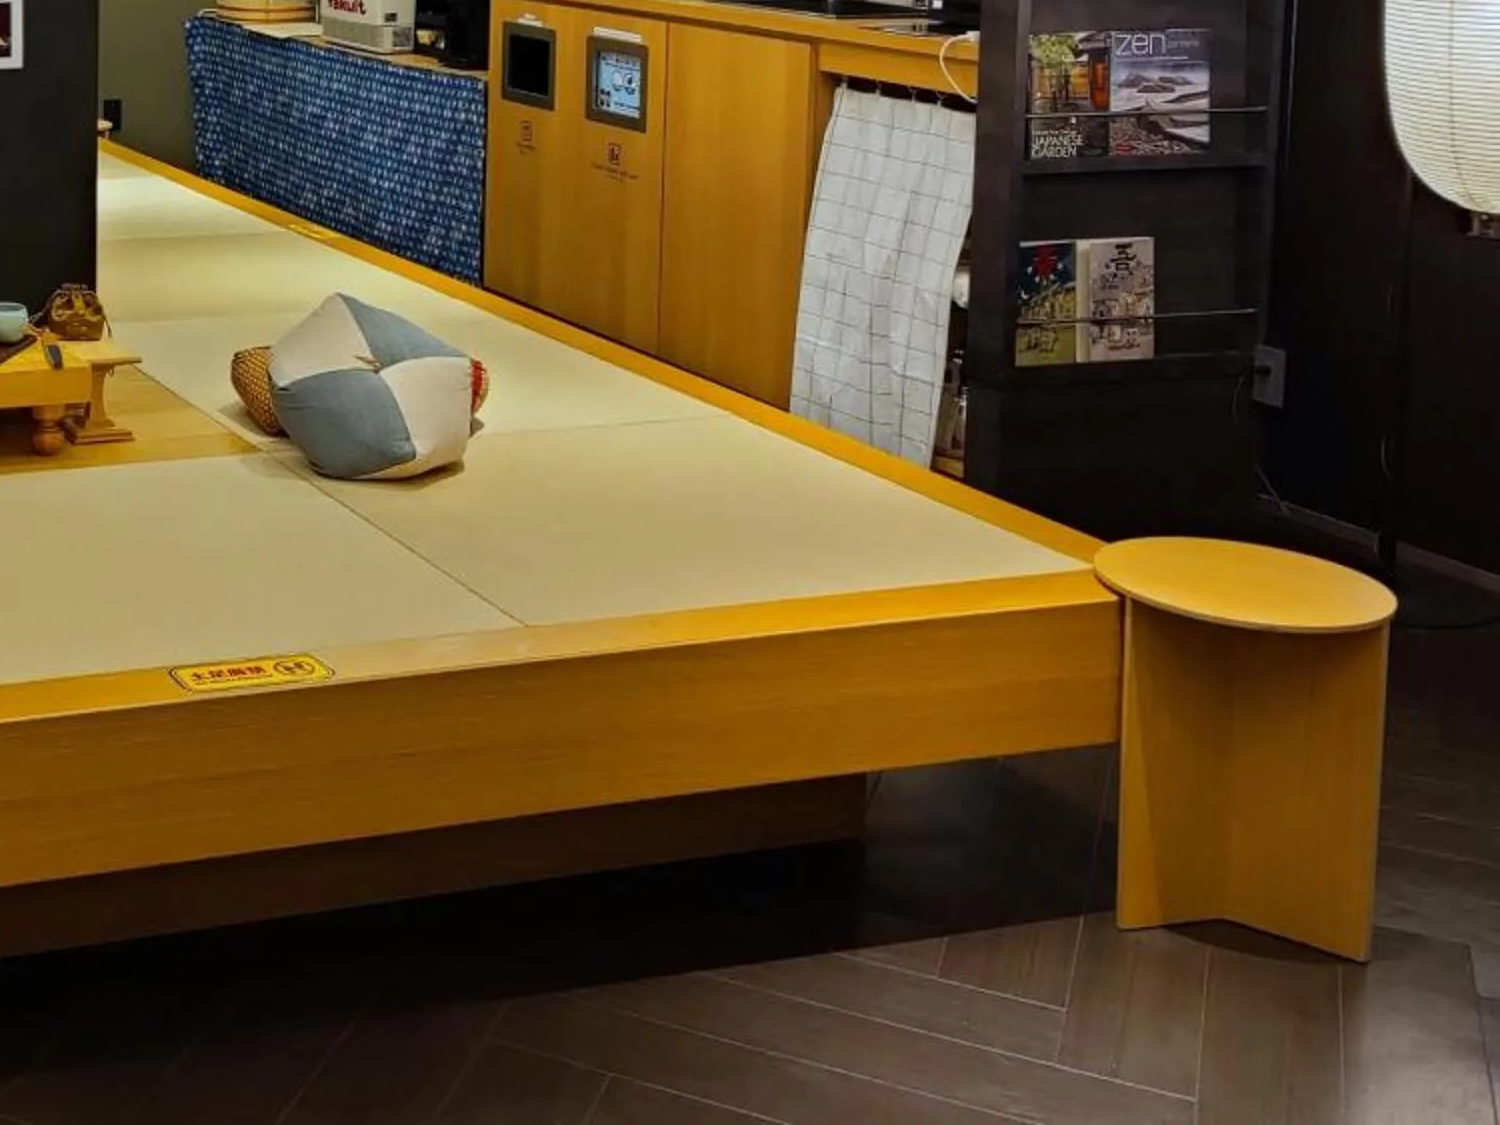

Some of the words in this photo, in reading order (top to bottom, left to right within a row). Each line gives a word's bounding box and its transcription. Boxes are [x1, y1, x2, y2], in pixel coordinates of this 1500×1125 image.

[1115, 33, 1168, 56] zen
[1034, 135, 1084, 146] JAPANESE
[1031, 144, 1077, 158] GARDEN
